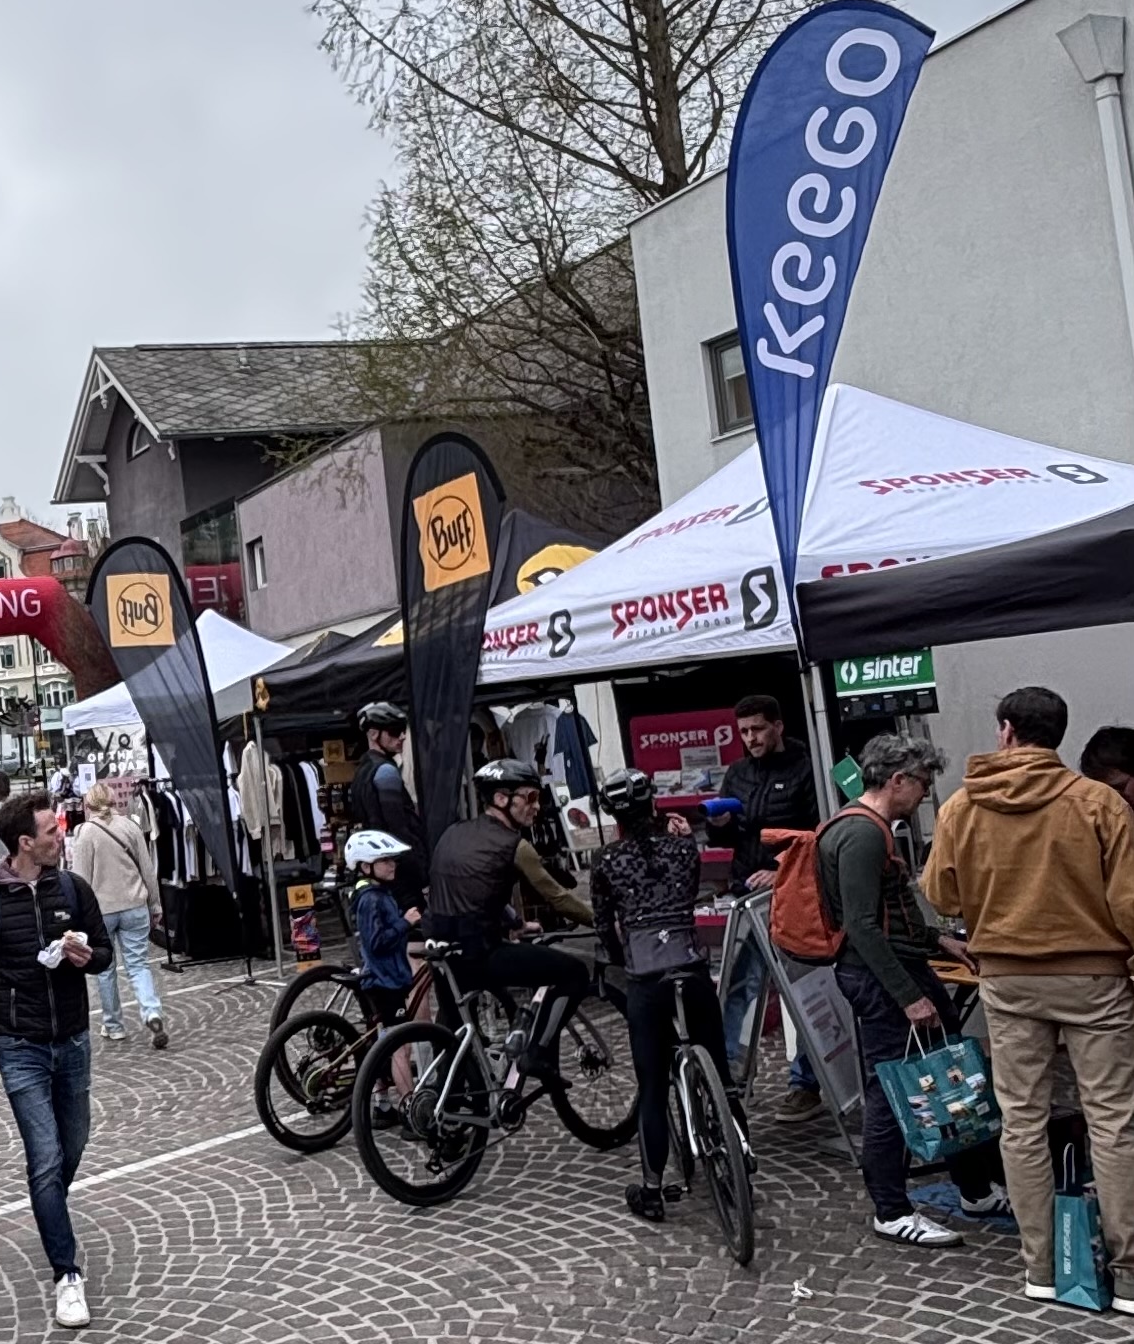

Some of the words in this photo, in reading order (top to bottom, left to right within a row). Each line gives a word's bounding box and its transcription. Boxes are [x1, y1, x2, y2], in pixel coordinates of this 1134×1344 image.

[858, 468, 1041, 495] SPONSER
[611, 583, 729, 640] SPONSER
[862, 655, 922, 681] sinter
[640, 729, 708, 749] SPONSER
